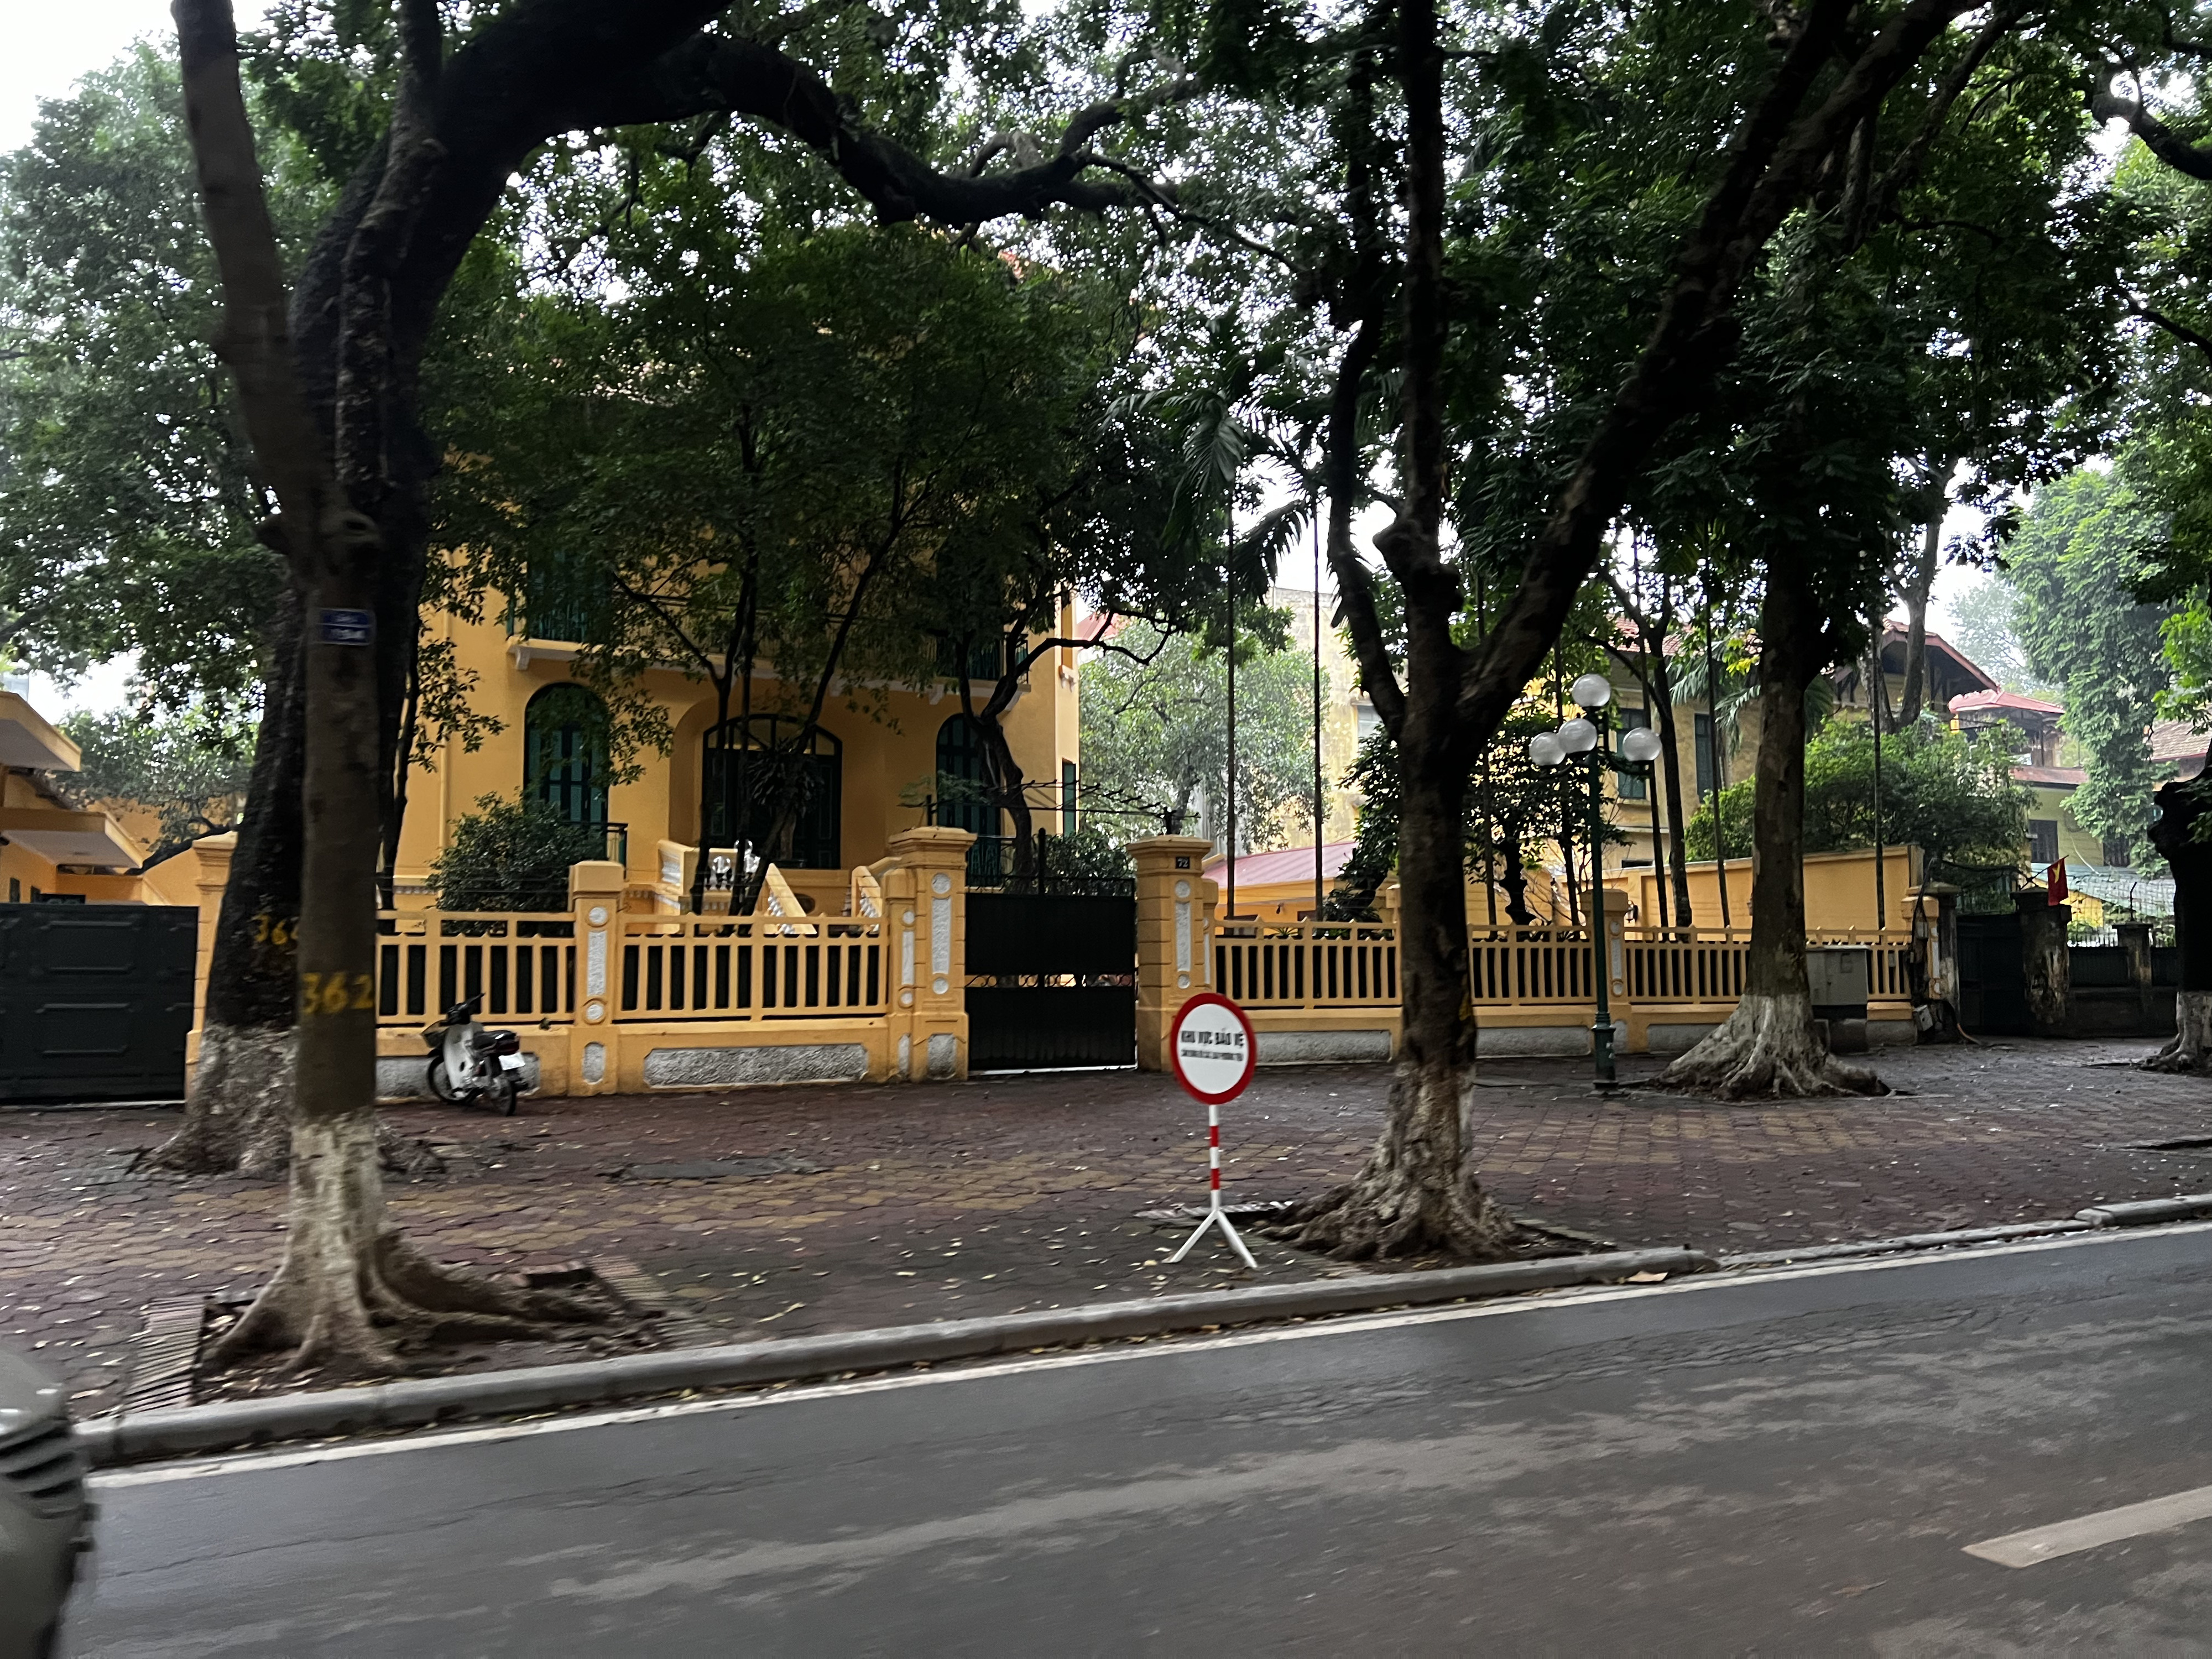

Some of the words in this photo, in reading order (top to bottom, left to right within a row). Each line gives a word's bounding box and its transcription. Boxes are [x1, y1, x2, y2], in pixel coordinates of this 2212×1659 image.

[1177, 858, 1188, 867] 72
[251, 914, 299, 945] 36
[302, 972, 374, 1014] 362
